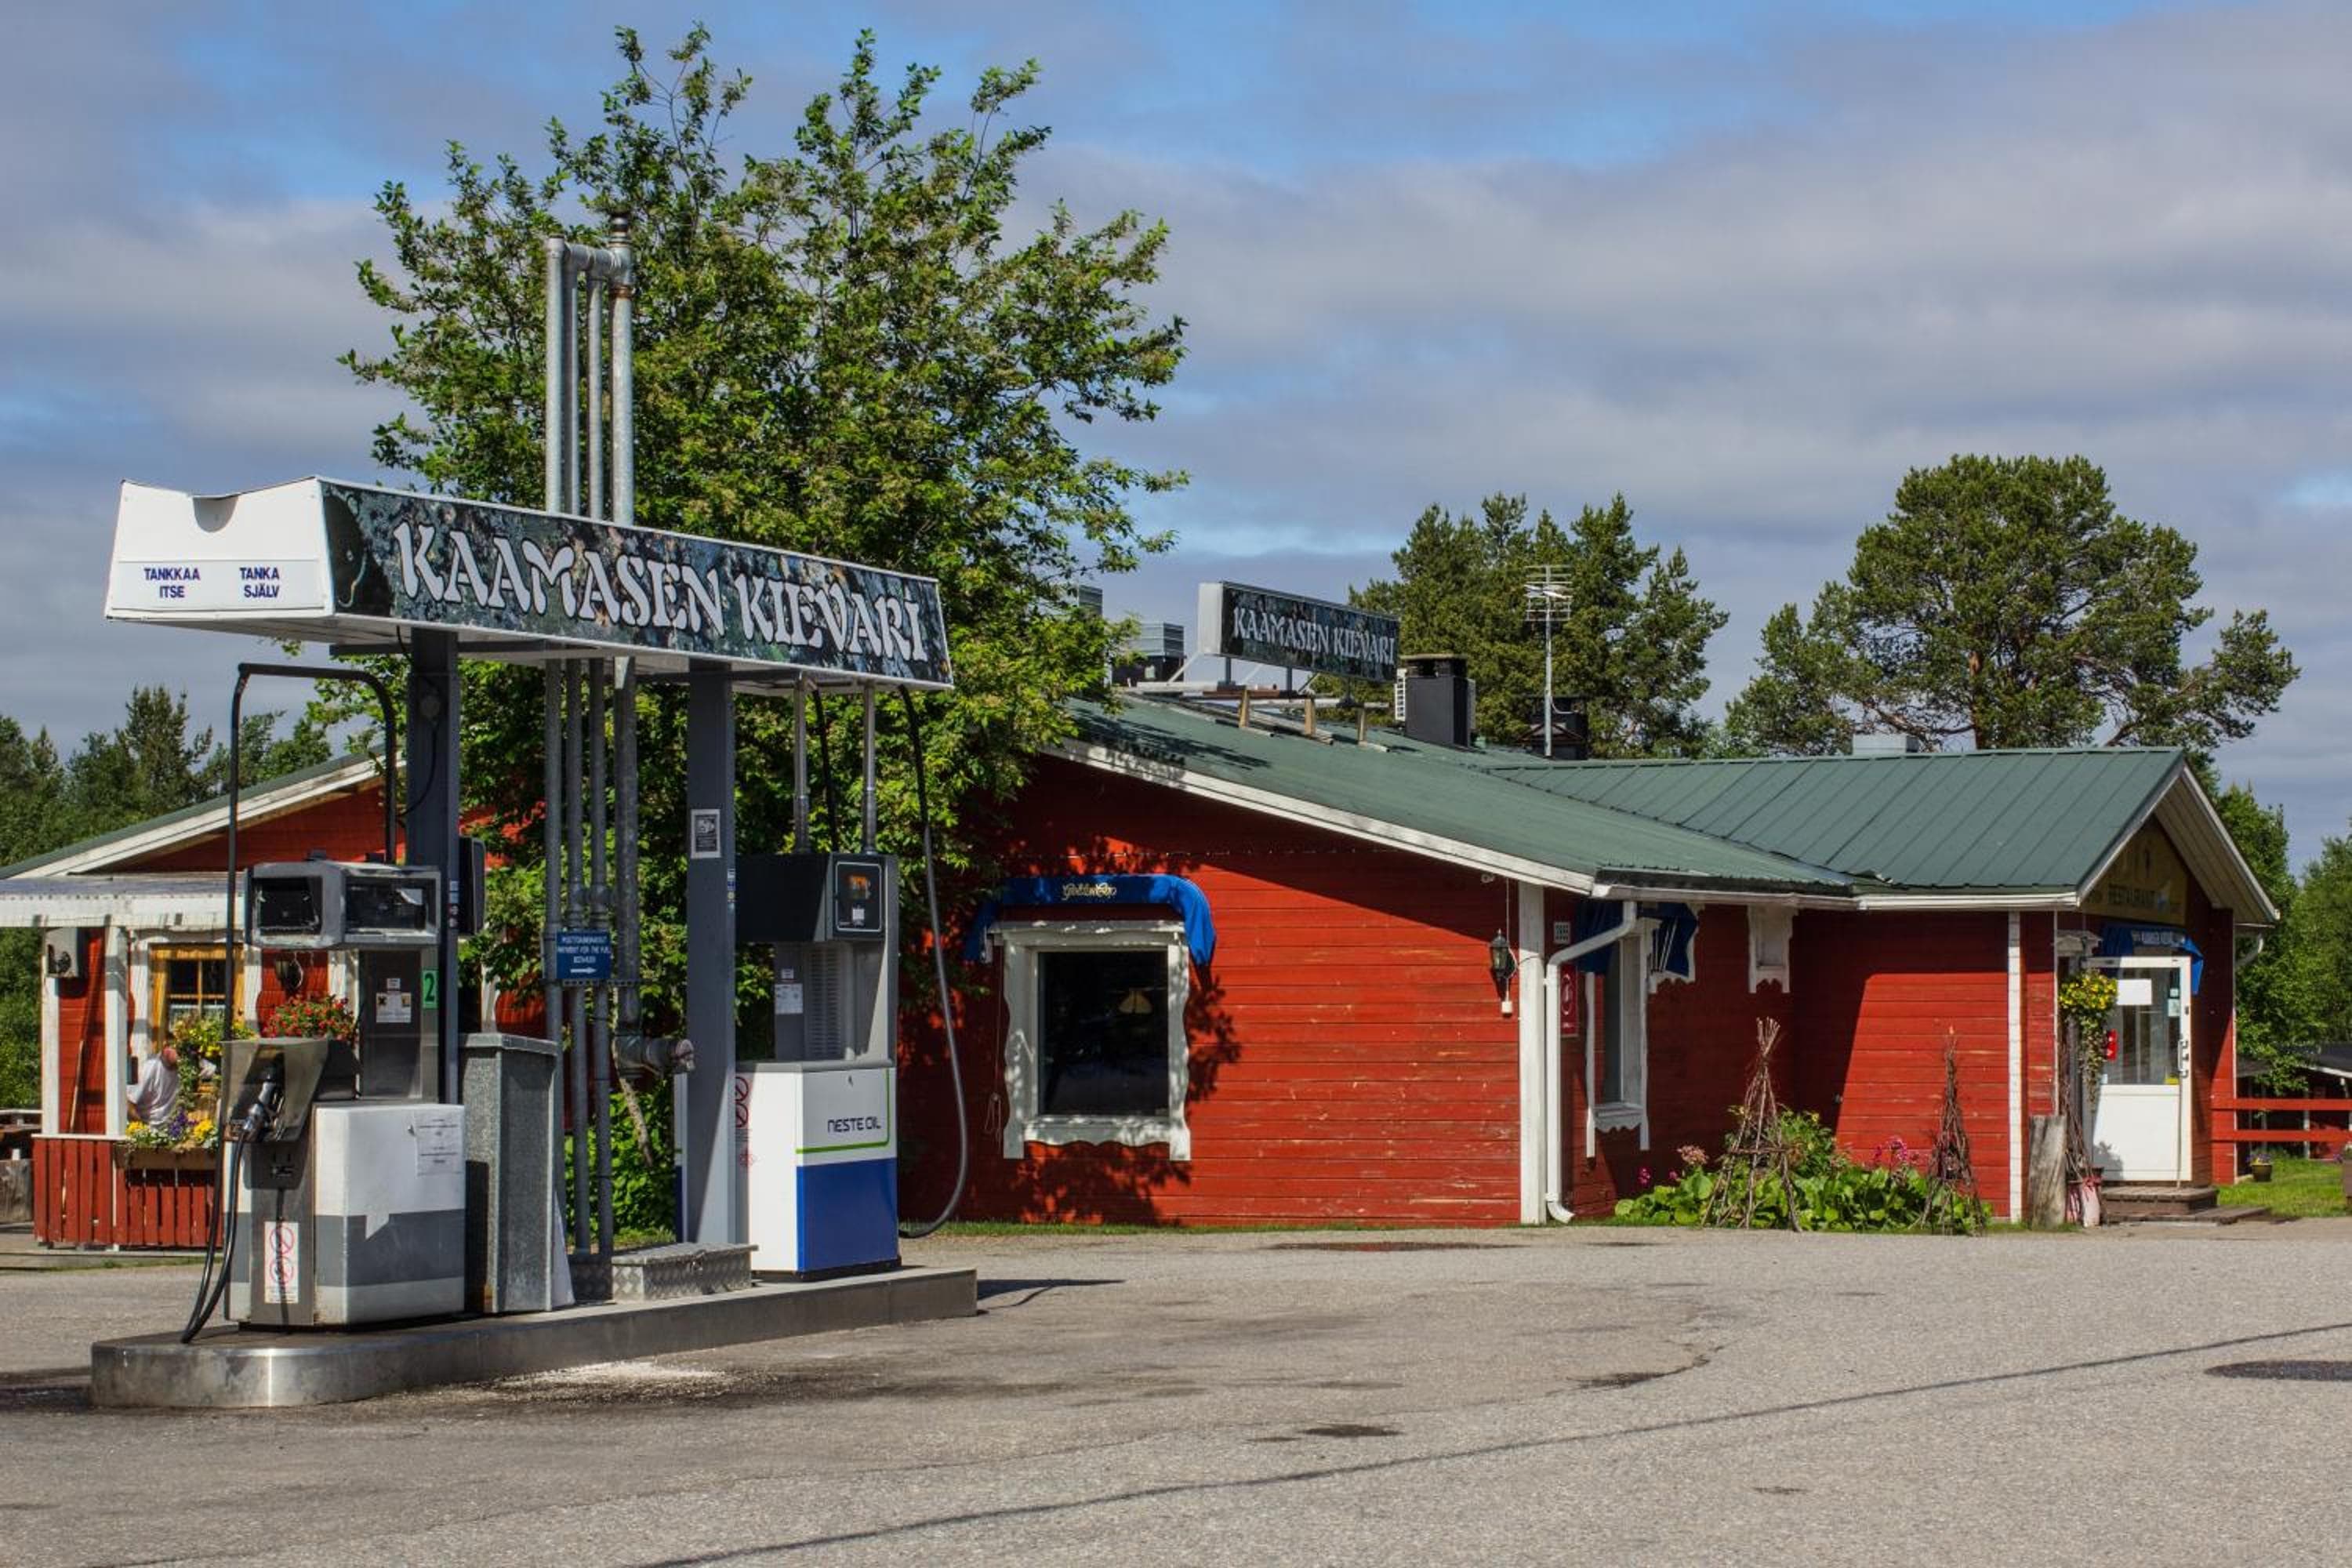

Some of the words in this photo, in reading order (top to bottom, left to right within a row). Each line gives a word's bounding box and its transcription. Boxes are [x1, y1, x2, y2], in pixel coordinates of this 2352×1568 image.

[143, 567, 200, 581] TANKKAA
[239, 567, 280, 581] TANKA
[159, 586, 185, 598] ITSE
[244, 583, 280, 598] SJÄLV
[393, 520, 725, 637] KAAMASEN
[734, 573, 928, 662] KIEVARI
[1233, 607, 1330, 654] KAAMASEN
[1334, 626, 1395, 665] KIEVARI
[424, 973, 435, 1003] 2
[827, 1117, 864, 1133] NESTE
